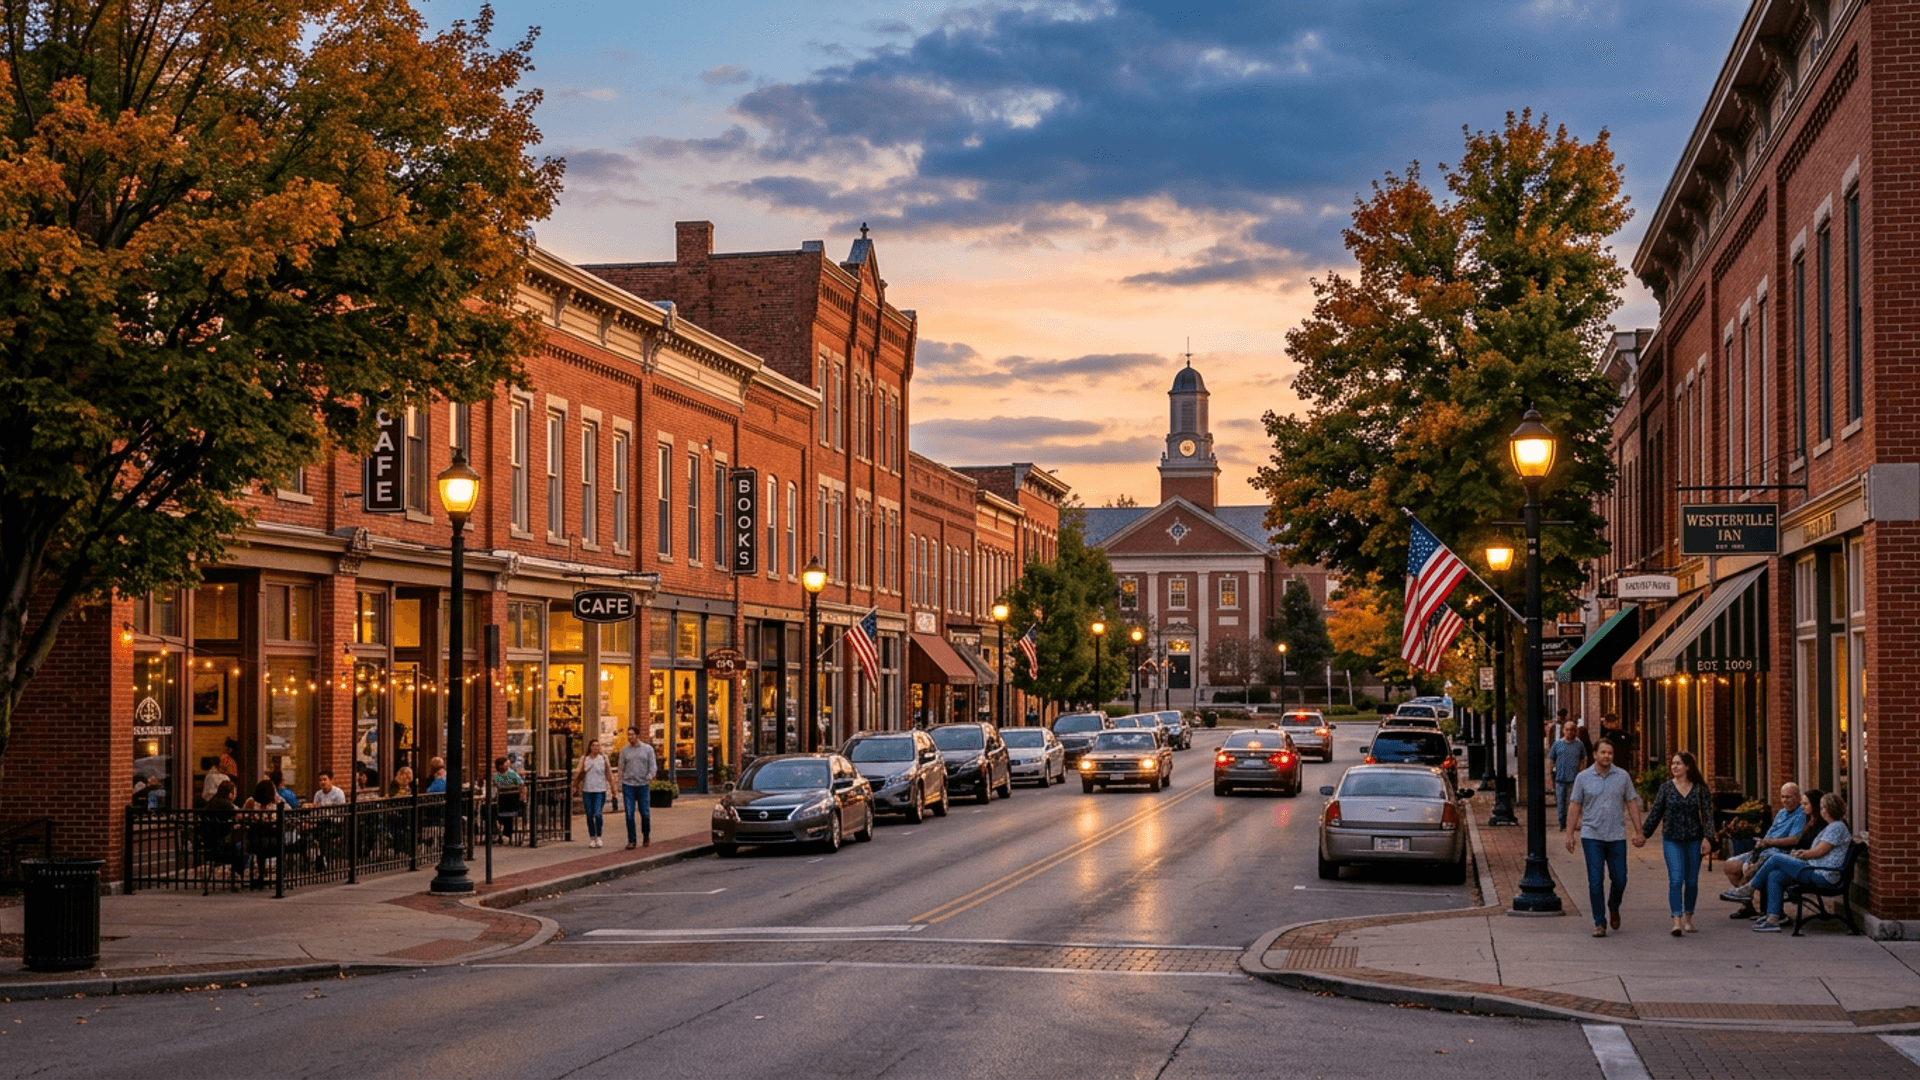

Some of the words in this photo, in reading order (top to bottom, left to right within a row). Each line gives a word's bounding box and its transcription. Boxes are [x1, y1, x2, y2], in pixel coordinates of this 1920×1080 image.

[374, 408, 395, 502] CAFE
[737, 479, 752, 566] BOOKS
[578, 597, 629, 615] CAFE
